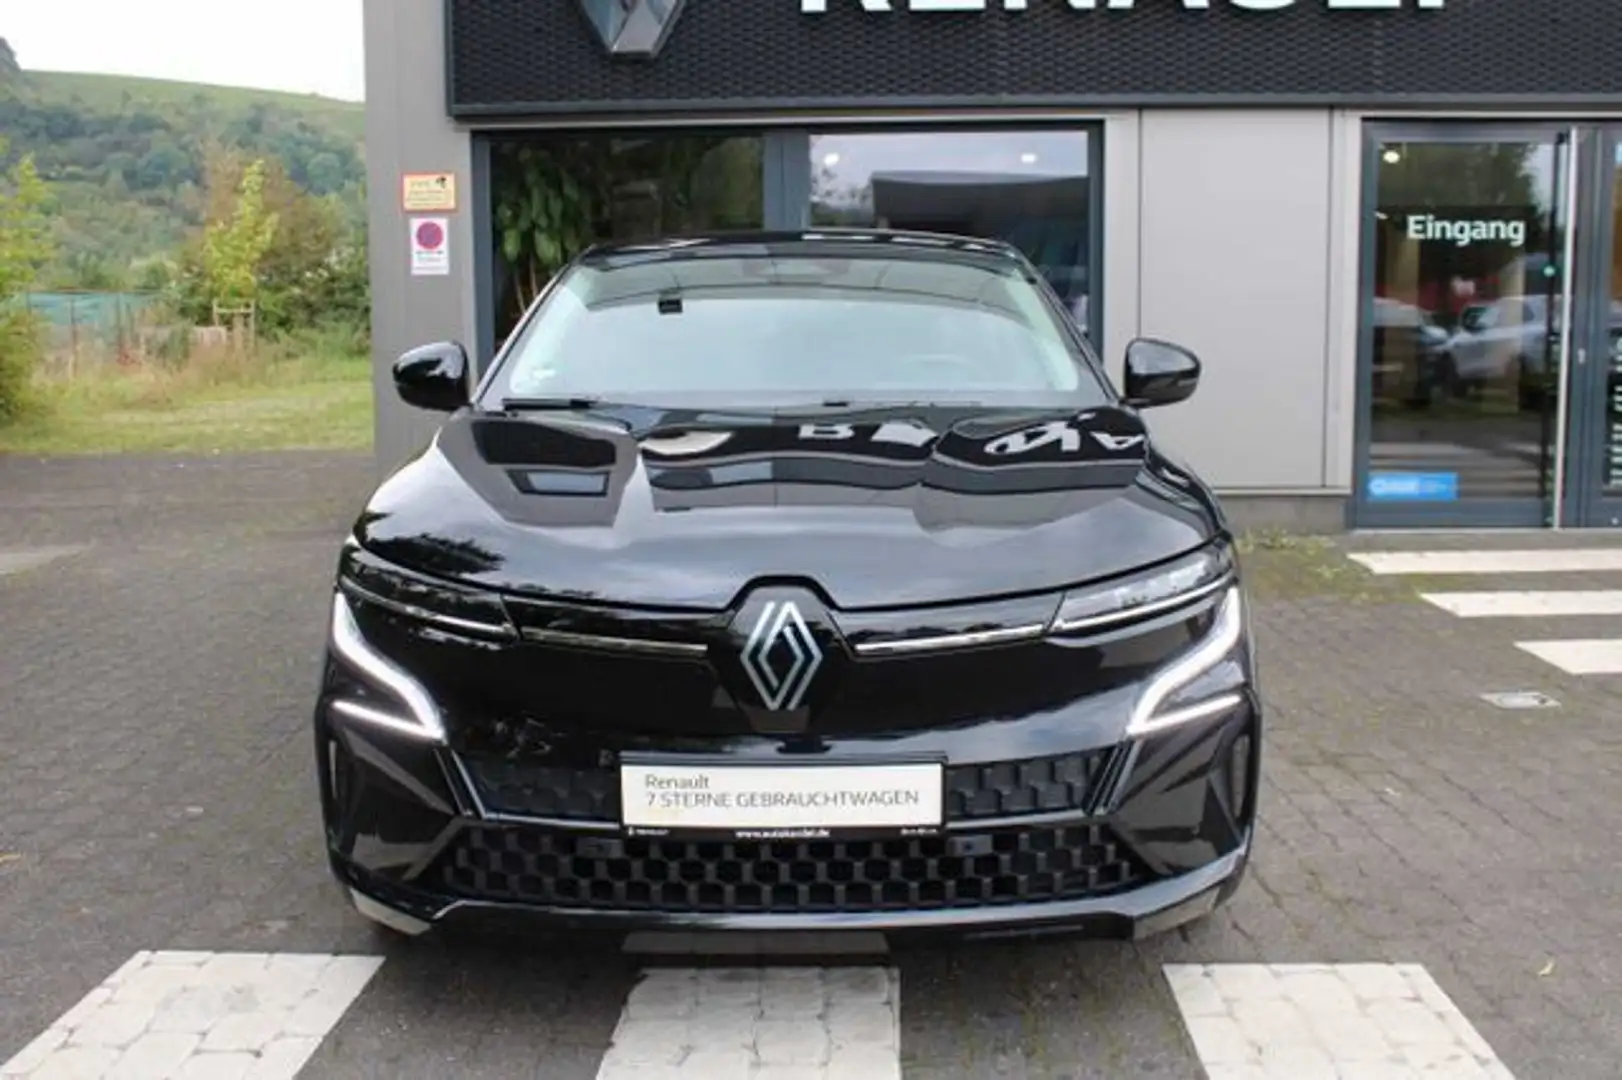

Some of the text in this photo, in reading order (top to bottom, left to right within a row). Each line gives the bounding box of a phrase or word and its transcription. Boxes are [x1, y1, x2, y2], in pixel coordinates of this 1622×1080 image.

[1406, 214, 1525, 246] Eingang
[645, 774, 710, 789] Renault
[645, 790, 919, 808] 7 STERNE GEBRAUCHTWAGEN
